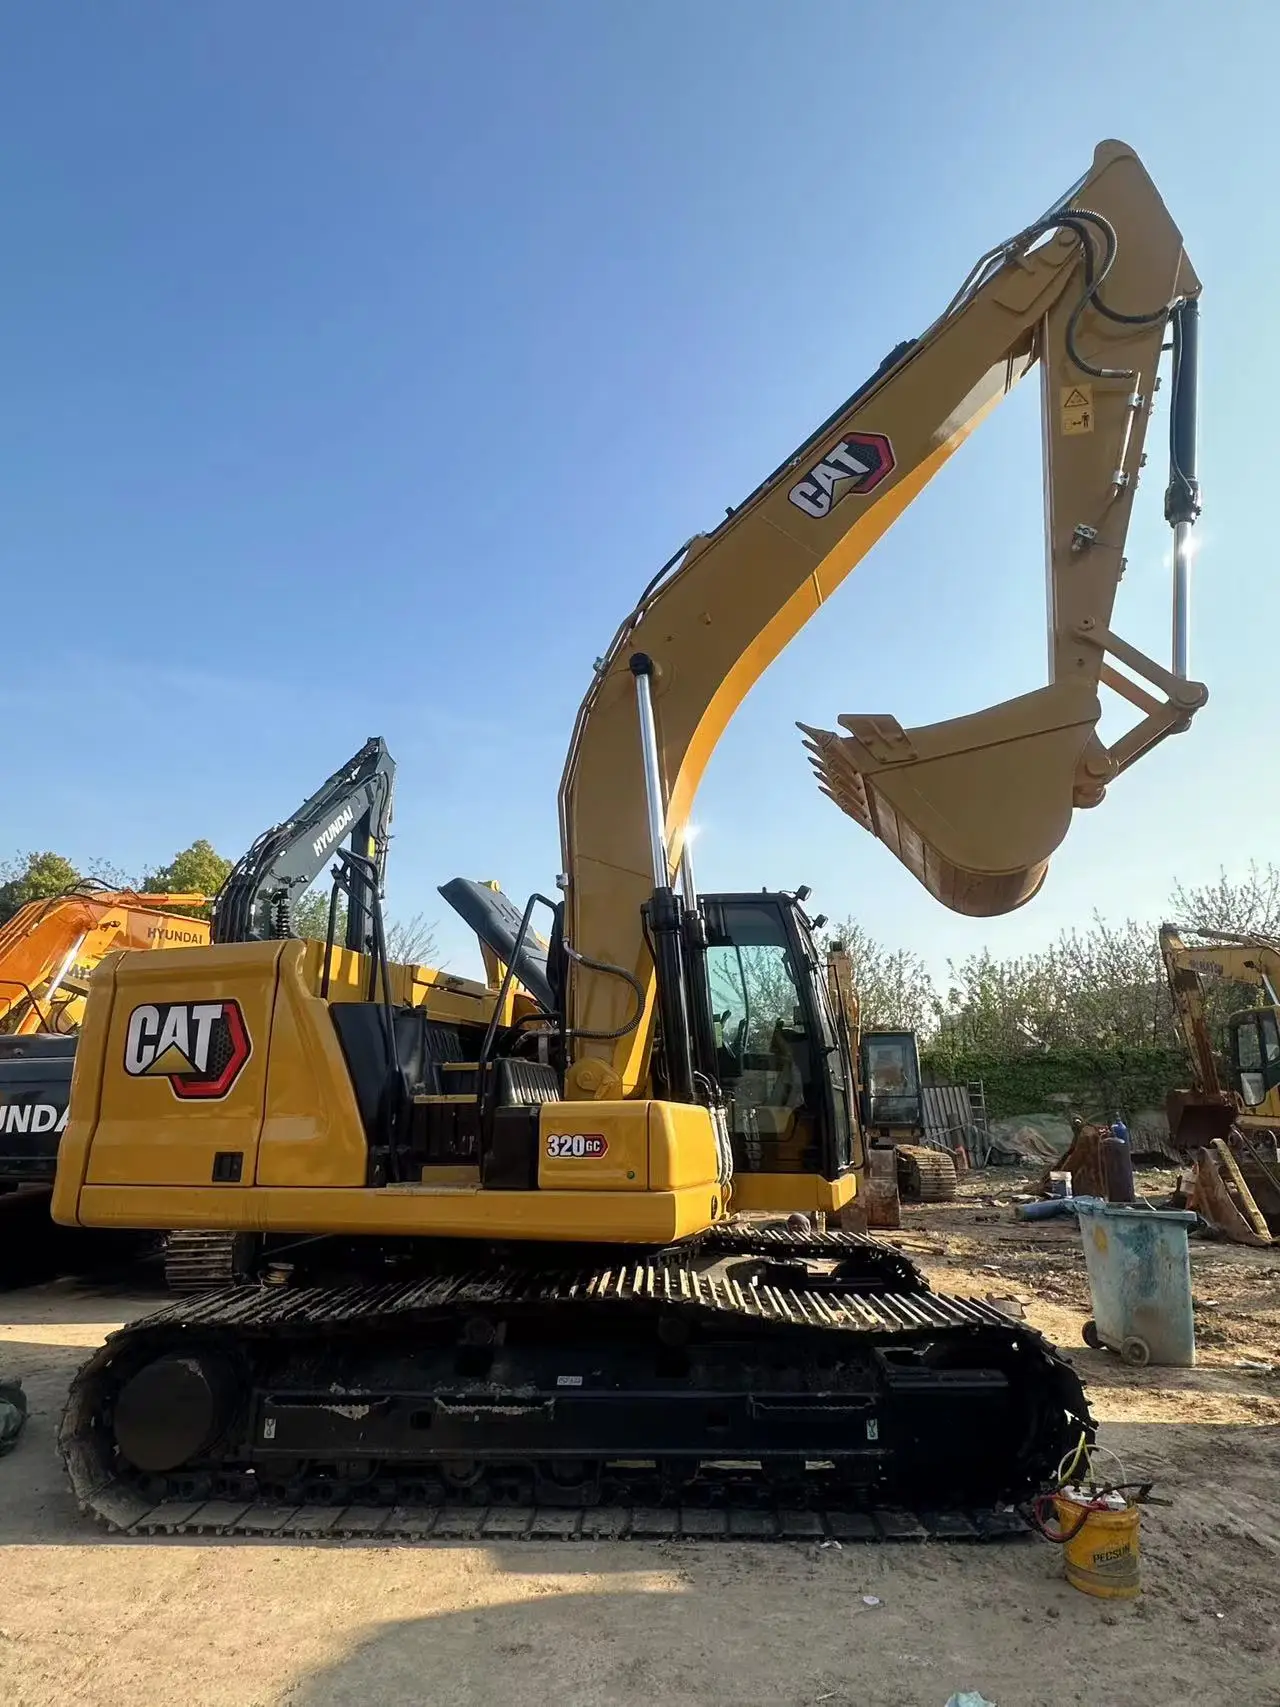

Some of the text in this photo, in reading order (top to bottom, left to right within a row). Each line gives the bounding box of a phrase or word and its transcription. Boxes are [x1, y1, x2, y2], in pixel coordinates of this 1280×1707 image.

[789, 441, 871, 518] CAT
[312, 805, 354, 857] HYUNDAI
[147, 927, 203, 945] HYUNDAI
[125, 1004, 223, 1074] CAT
